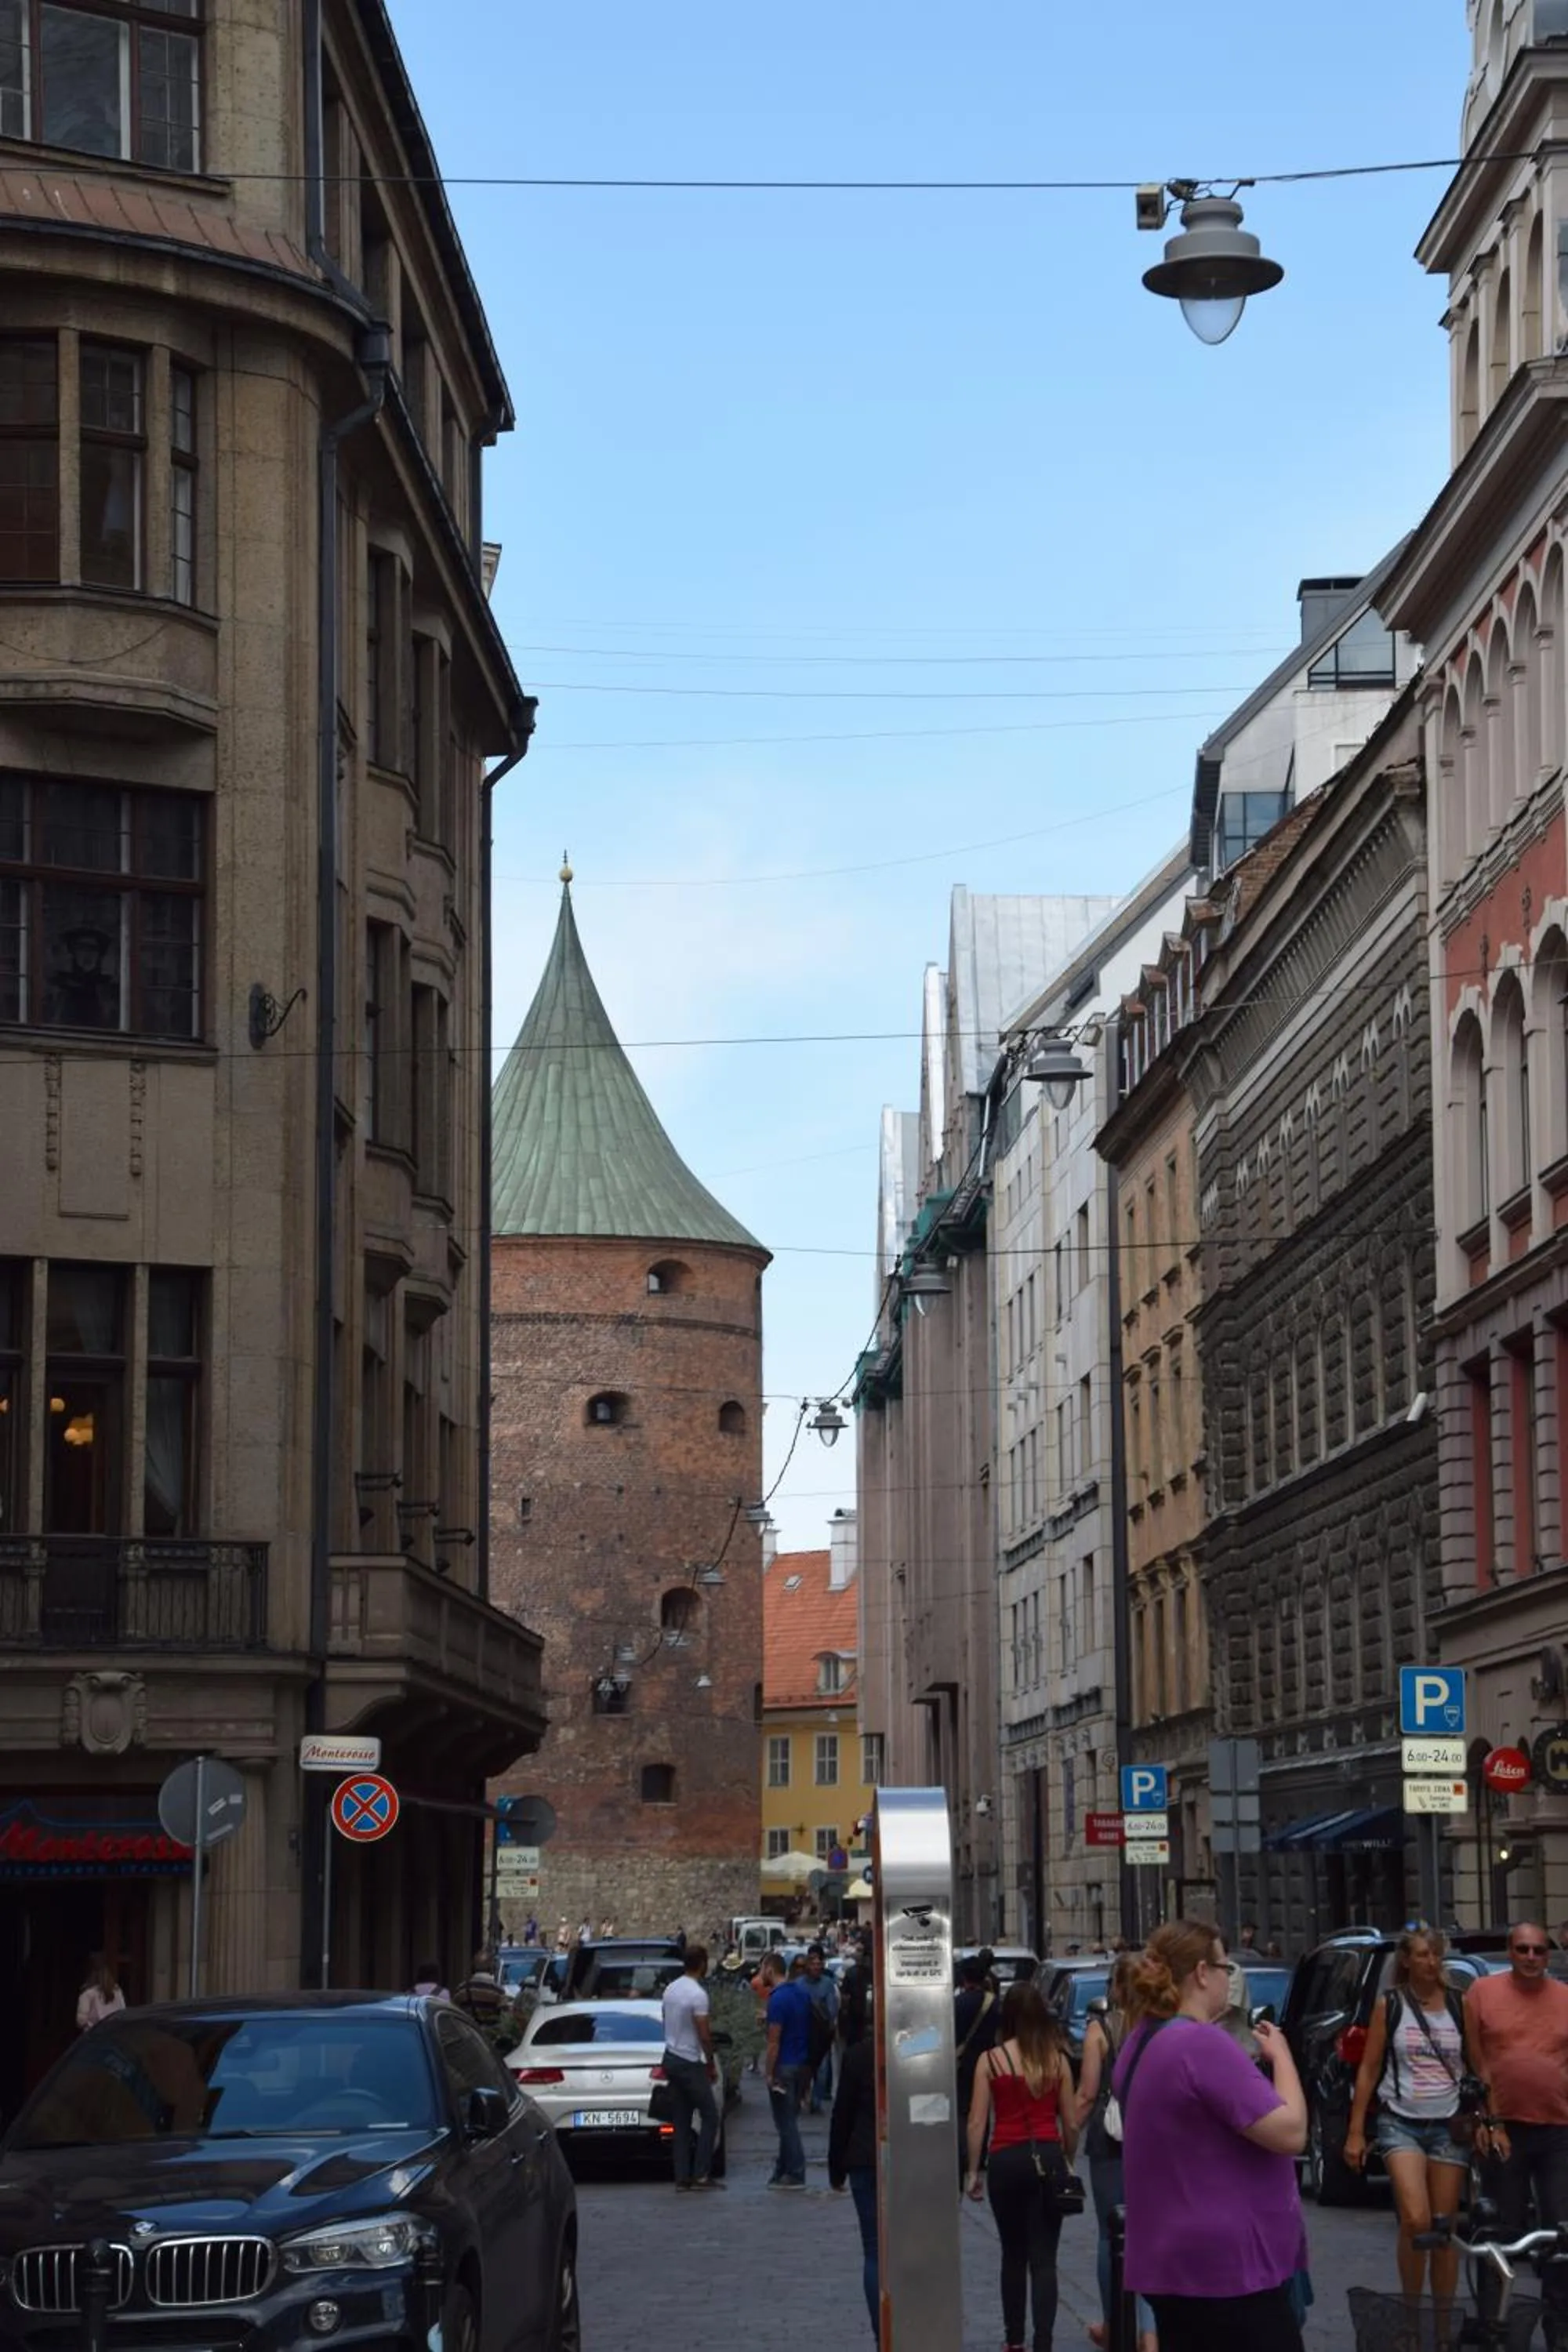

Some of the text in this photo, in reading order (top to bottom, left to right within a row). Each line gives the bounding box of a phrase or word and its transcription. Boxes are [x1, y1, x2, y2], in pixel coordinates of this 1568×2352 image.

[1415, 1675, 1450, 1726] P
[1489, 1759, 1526, 1779] Leica
[1131, 1770, 1156, 1806] P
